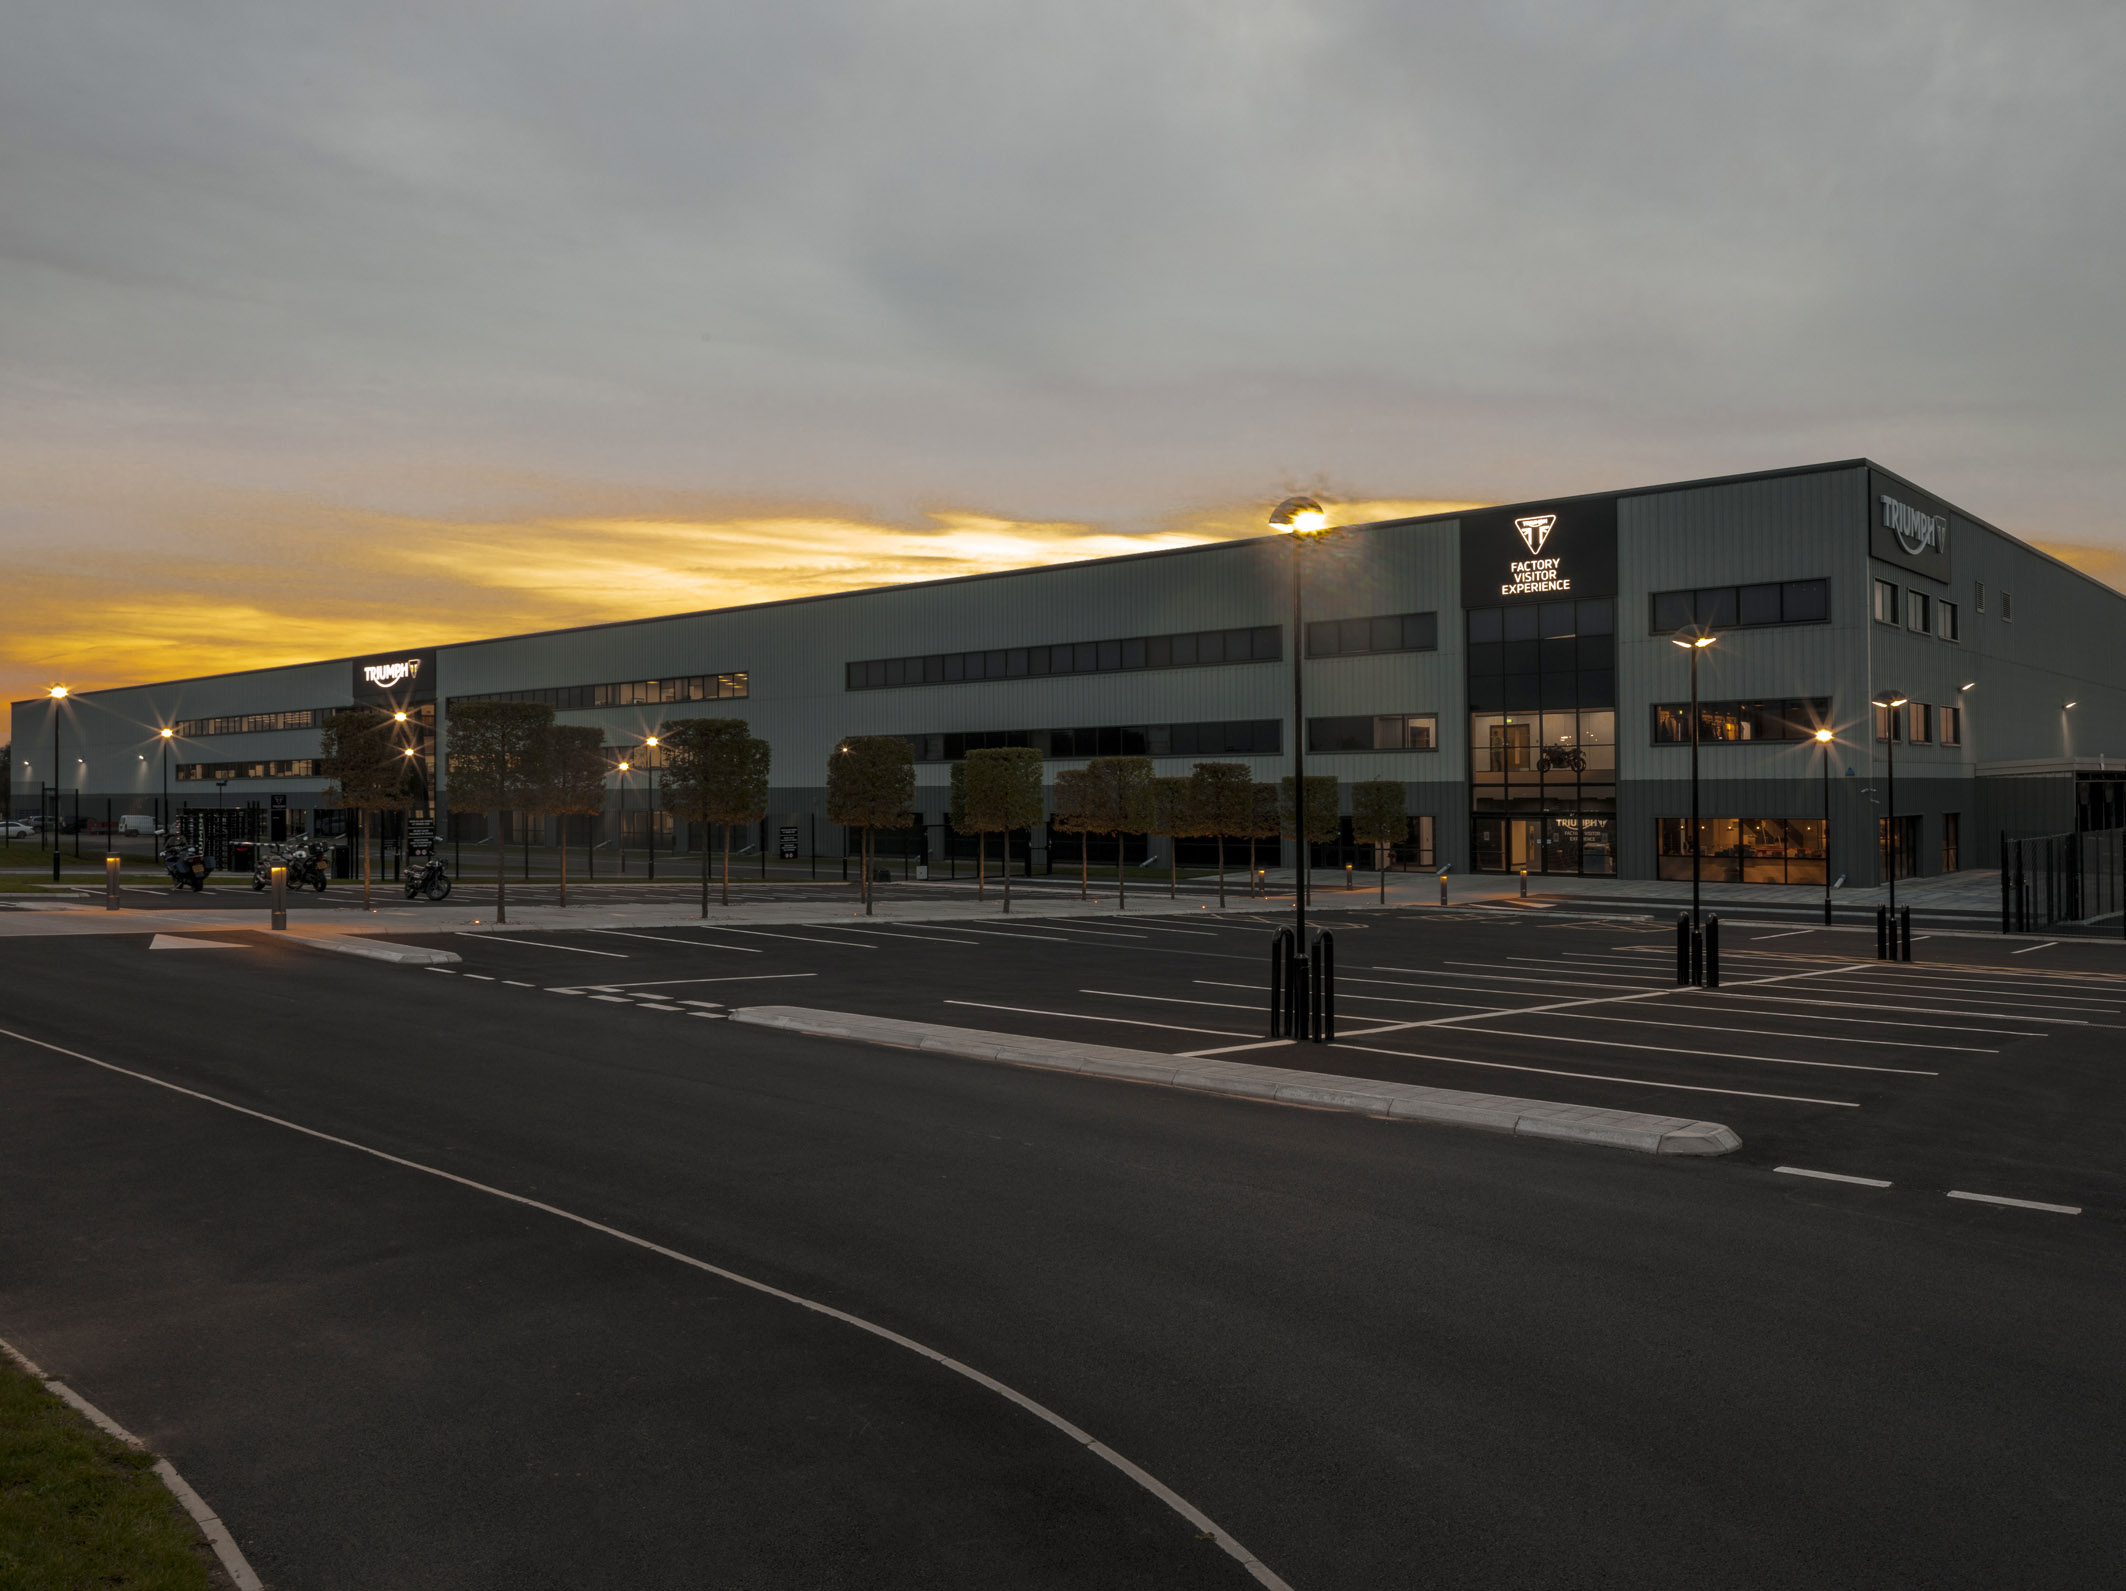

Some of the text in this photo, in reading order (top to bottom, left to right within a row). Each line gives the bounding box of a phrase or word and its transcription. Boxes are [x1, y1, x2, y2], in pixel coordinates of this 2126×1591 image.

[1880, 495, 1936, 555] TRIUMPH
[1511, 558, 1560, 573] FACTORY
[1514, 569, 1557, 583] VISITOR
[1501, 579, 1570, 595] EXPERIENCE
[364, 662, 408, 687] TRIUMPH
[1555, 819, 1597, 830] TRIUPH
